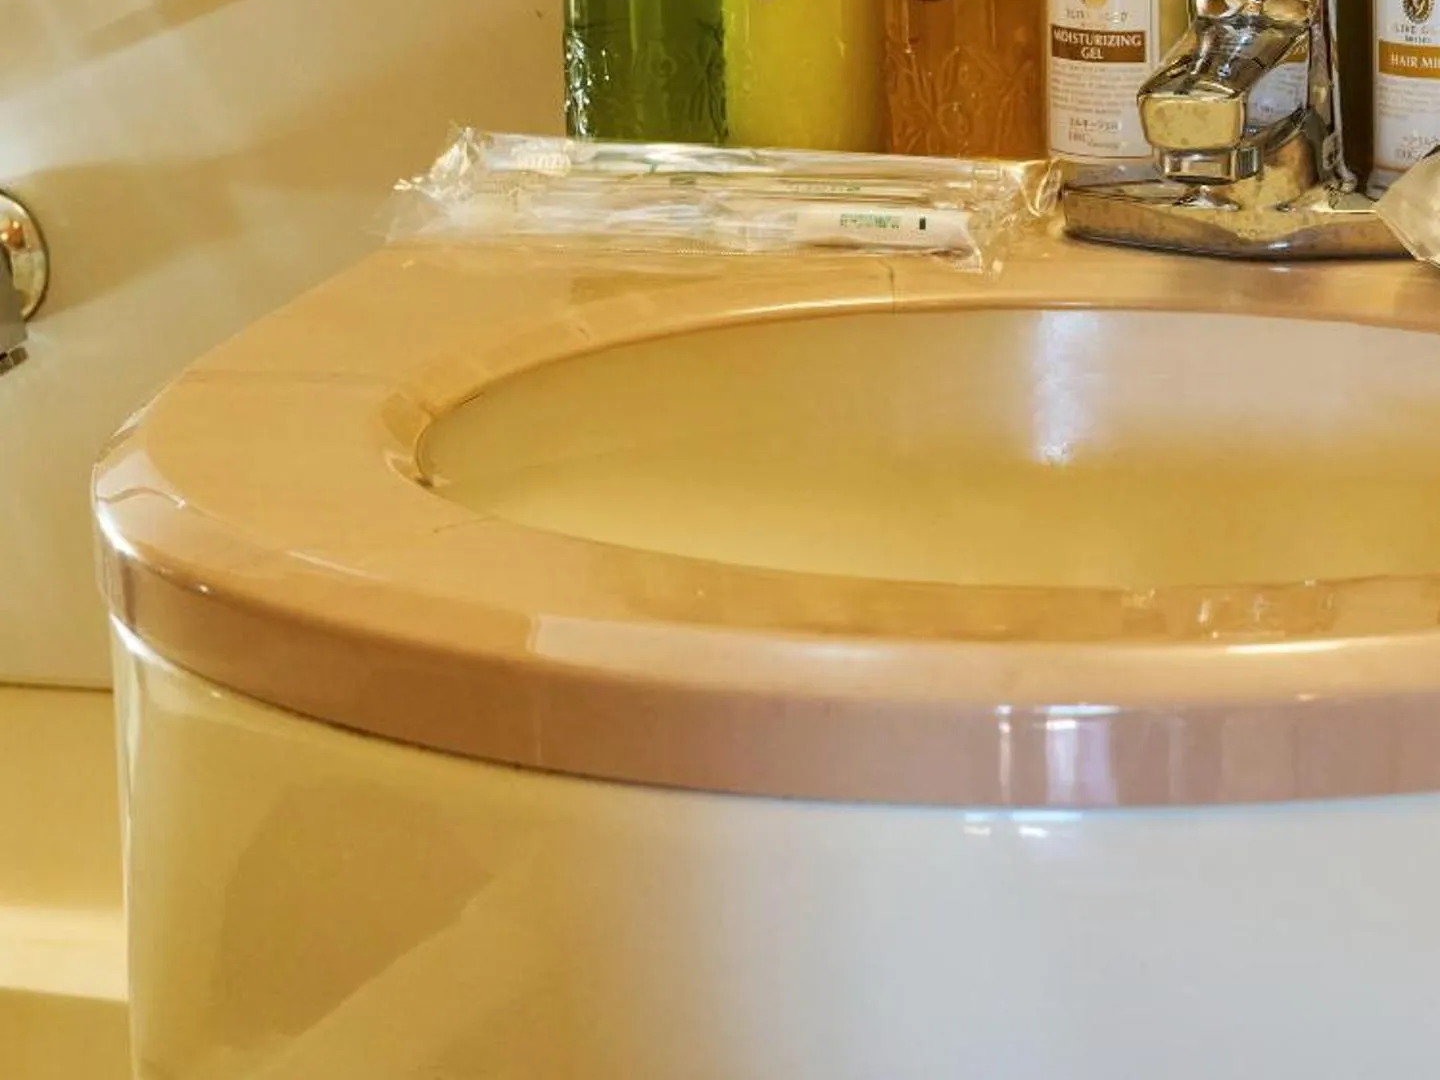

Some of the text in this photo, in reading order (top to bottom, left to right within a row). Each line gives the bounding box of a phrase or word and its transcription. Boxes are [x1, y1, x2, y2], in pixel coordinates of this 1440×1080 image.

[1053, 30, 1142, 47] MOISTURIZING
[1080, 46, 1105, 60] GEL
[1390, 53, 1419, 69] HAIR
